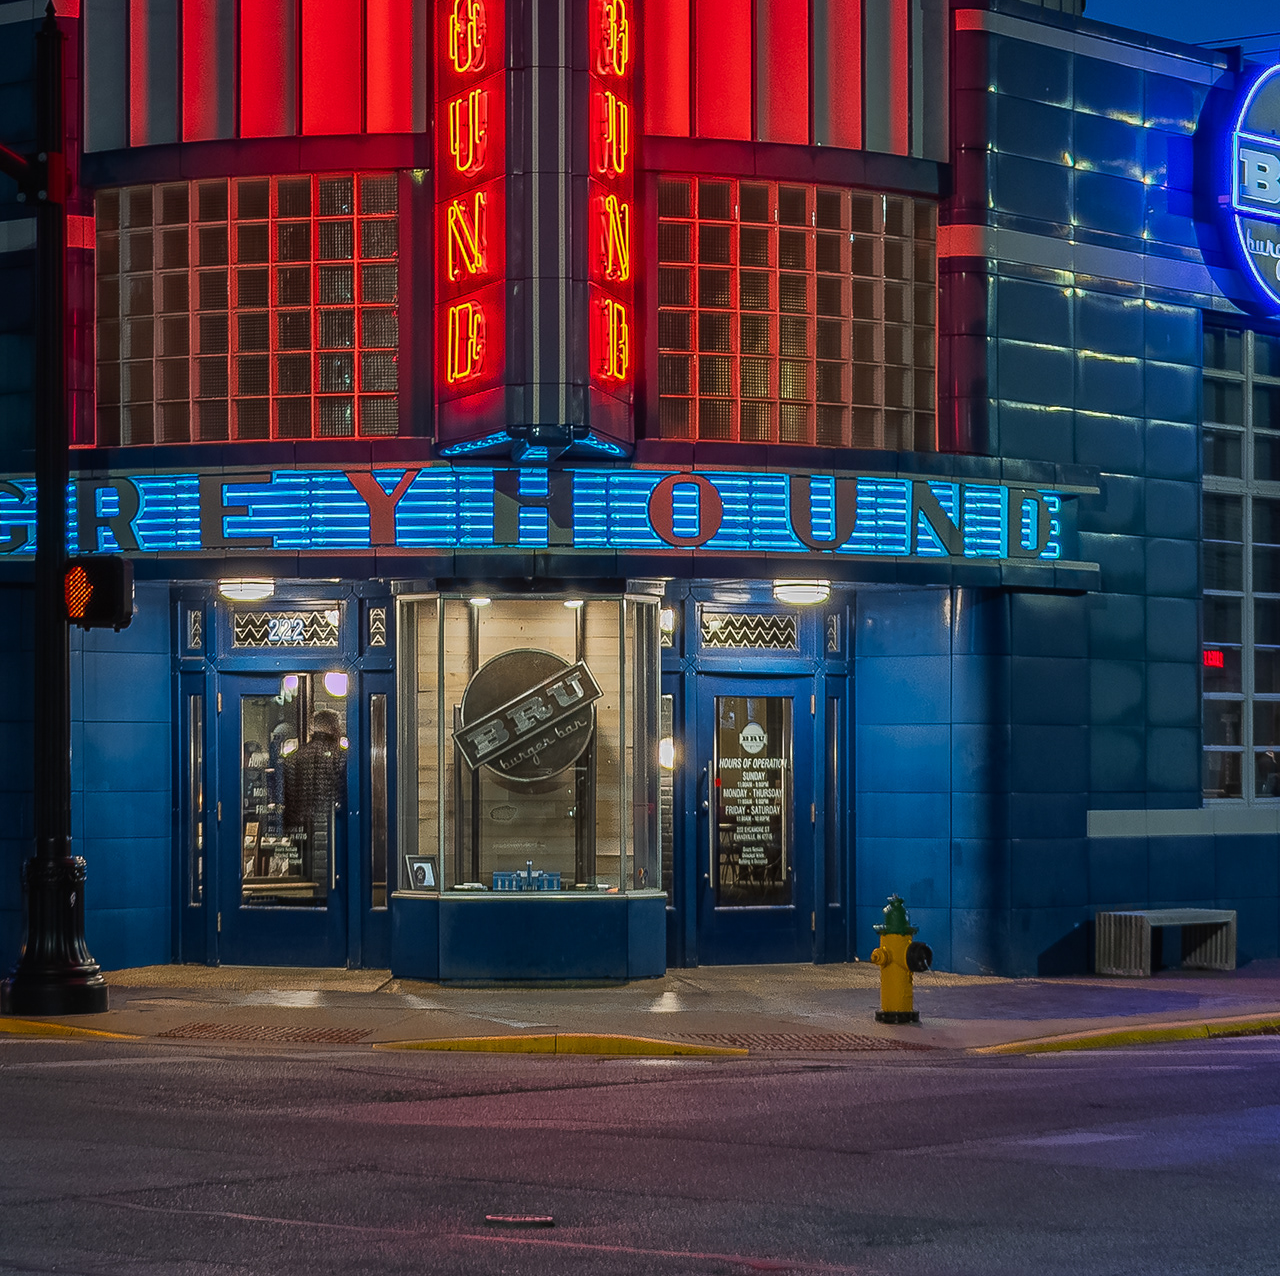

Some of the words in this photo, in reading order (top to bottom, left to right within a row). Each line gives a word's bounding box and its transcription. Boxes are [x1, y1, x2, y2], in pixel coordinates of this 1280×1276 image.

[268, 618, 306, 641] 222
[463, 670, 586, 759] BRU
[499, 736, 557, 771] burger
[554, 719, 588, 739] bar
[719, 757, 742, 769] HOURS
[742, 758, 753, 769] OF
[742, 771, 766, 781] SUNDAY
[723, 789, 748, 798] MONDAY
[753, 788, 782, 798] THURSDAY
[725, 805, 746, 816] FRIDAY
[751, 805, 781, 816] SATURDAY
